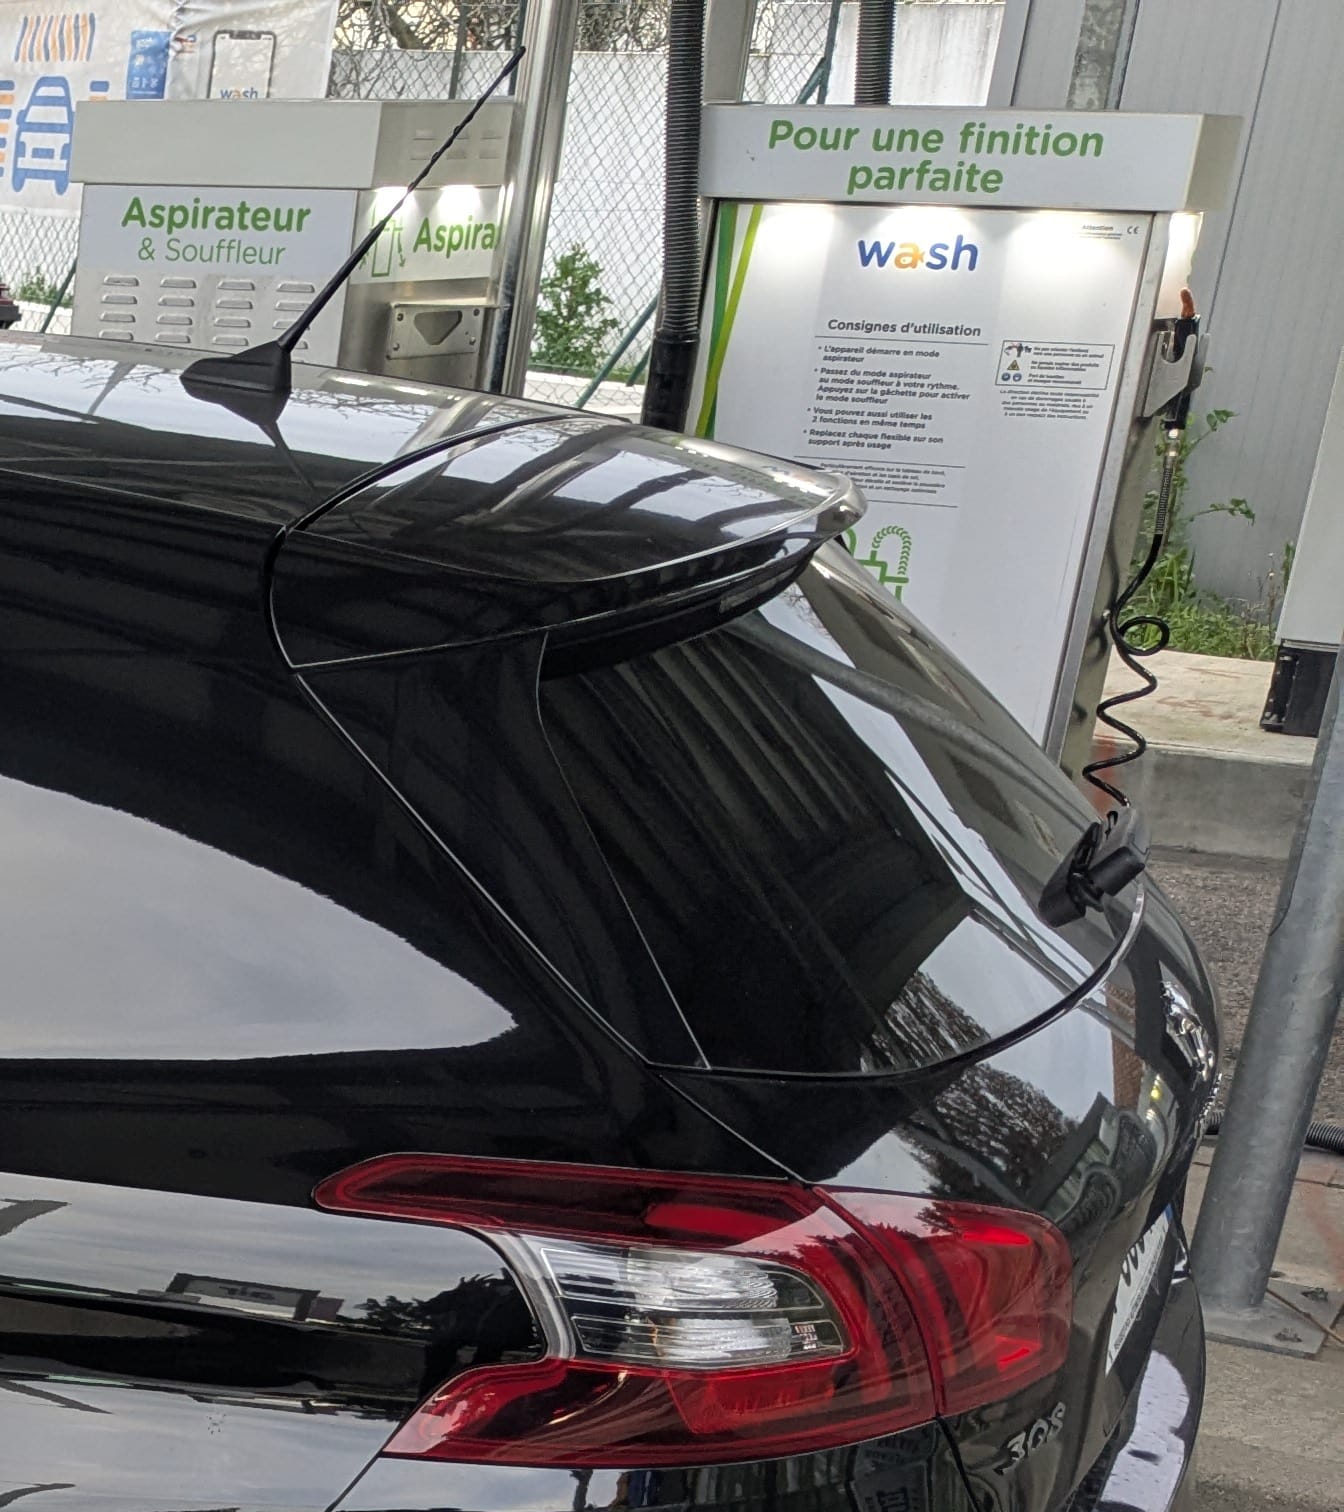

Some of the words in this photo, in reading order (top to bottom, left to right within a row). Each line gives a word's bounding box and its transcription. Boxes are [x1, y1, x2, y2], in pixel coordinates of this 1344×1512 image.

[768, 119, 860, 151] Pour
[872, 127, 944, 153] une
[959, 121, 1104, 158] finition
[847, 159, 1003, 195] parfaite
[121, 197, 311, 235] Aspirateur
[413, 213, 498, 258] Aspira
[138, 238, 156, 260] &
[165, 237, 286, 266] Souffleur
[857, 234, 980, 272] wash
[827, 319, 897, 333] Consignes
[900, 322, 981, 337] d'utilisation
[824, 345, 864, 354] L'appareil
[866, 346, 901, 356] démarre
[915, 349, 940, 357] mode
[822, 354, 864, 363] aspirateur
[820, 367, 848, 376] Passez
[863, 369, 886, 377] mode
[888, 371, 932, 380] aspirateur
[831, 376, 855, 384] mode
[856, 378, 893, 387] souffleur
[903, 381, 925, 389] votre
[817, 385, 853, 395] Appuyez
[918, 390, 939, 398] pour
[941, 391, 970, 400] activer
[825, 394, 849, 402] mode
[813, 407, 833, 415] Vous
[835, 409, 865, 417] pouvez
[866, 410, 888, 418] aussi
[890, 411, 919, 420] utiliser
[819, 416, 858, 425] fonctions
[871, 418, 898, 428] même
[900, 420, 926, 429] temps
[809, 429, 846, 438] Replacez
[848, 431, 878, 440] chaque
[880, 432, 911, 442] flexible
[808, 438, 840, 447] support
[842, 439, 865, 448] après
[866, 442, 892, 450] usage
